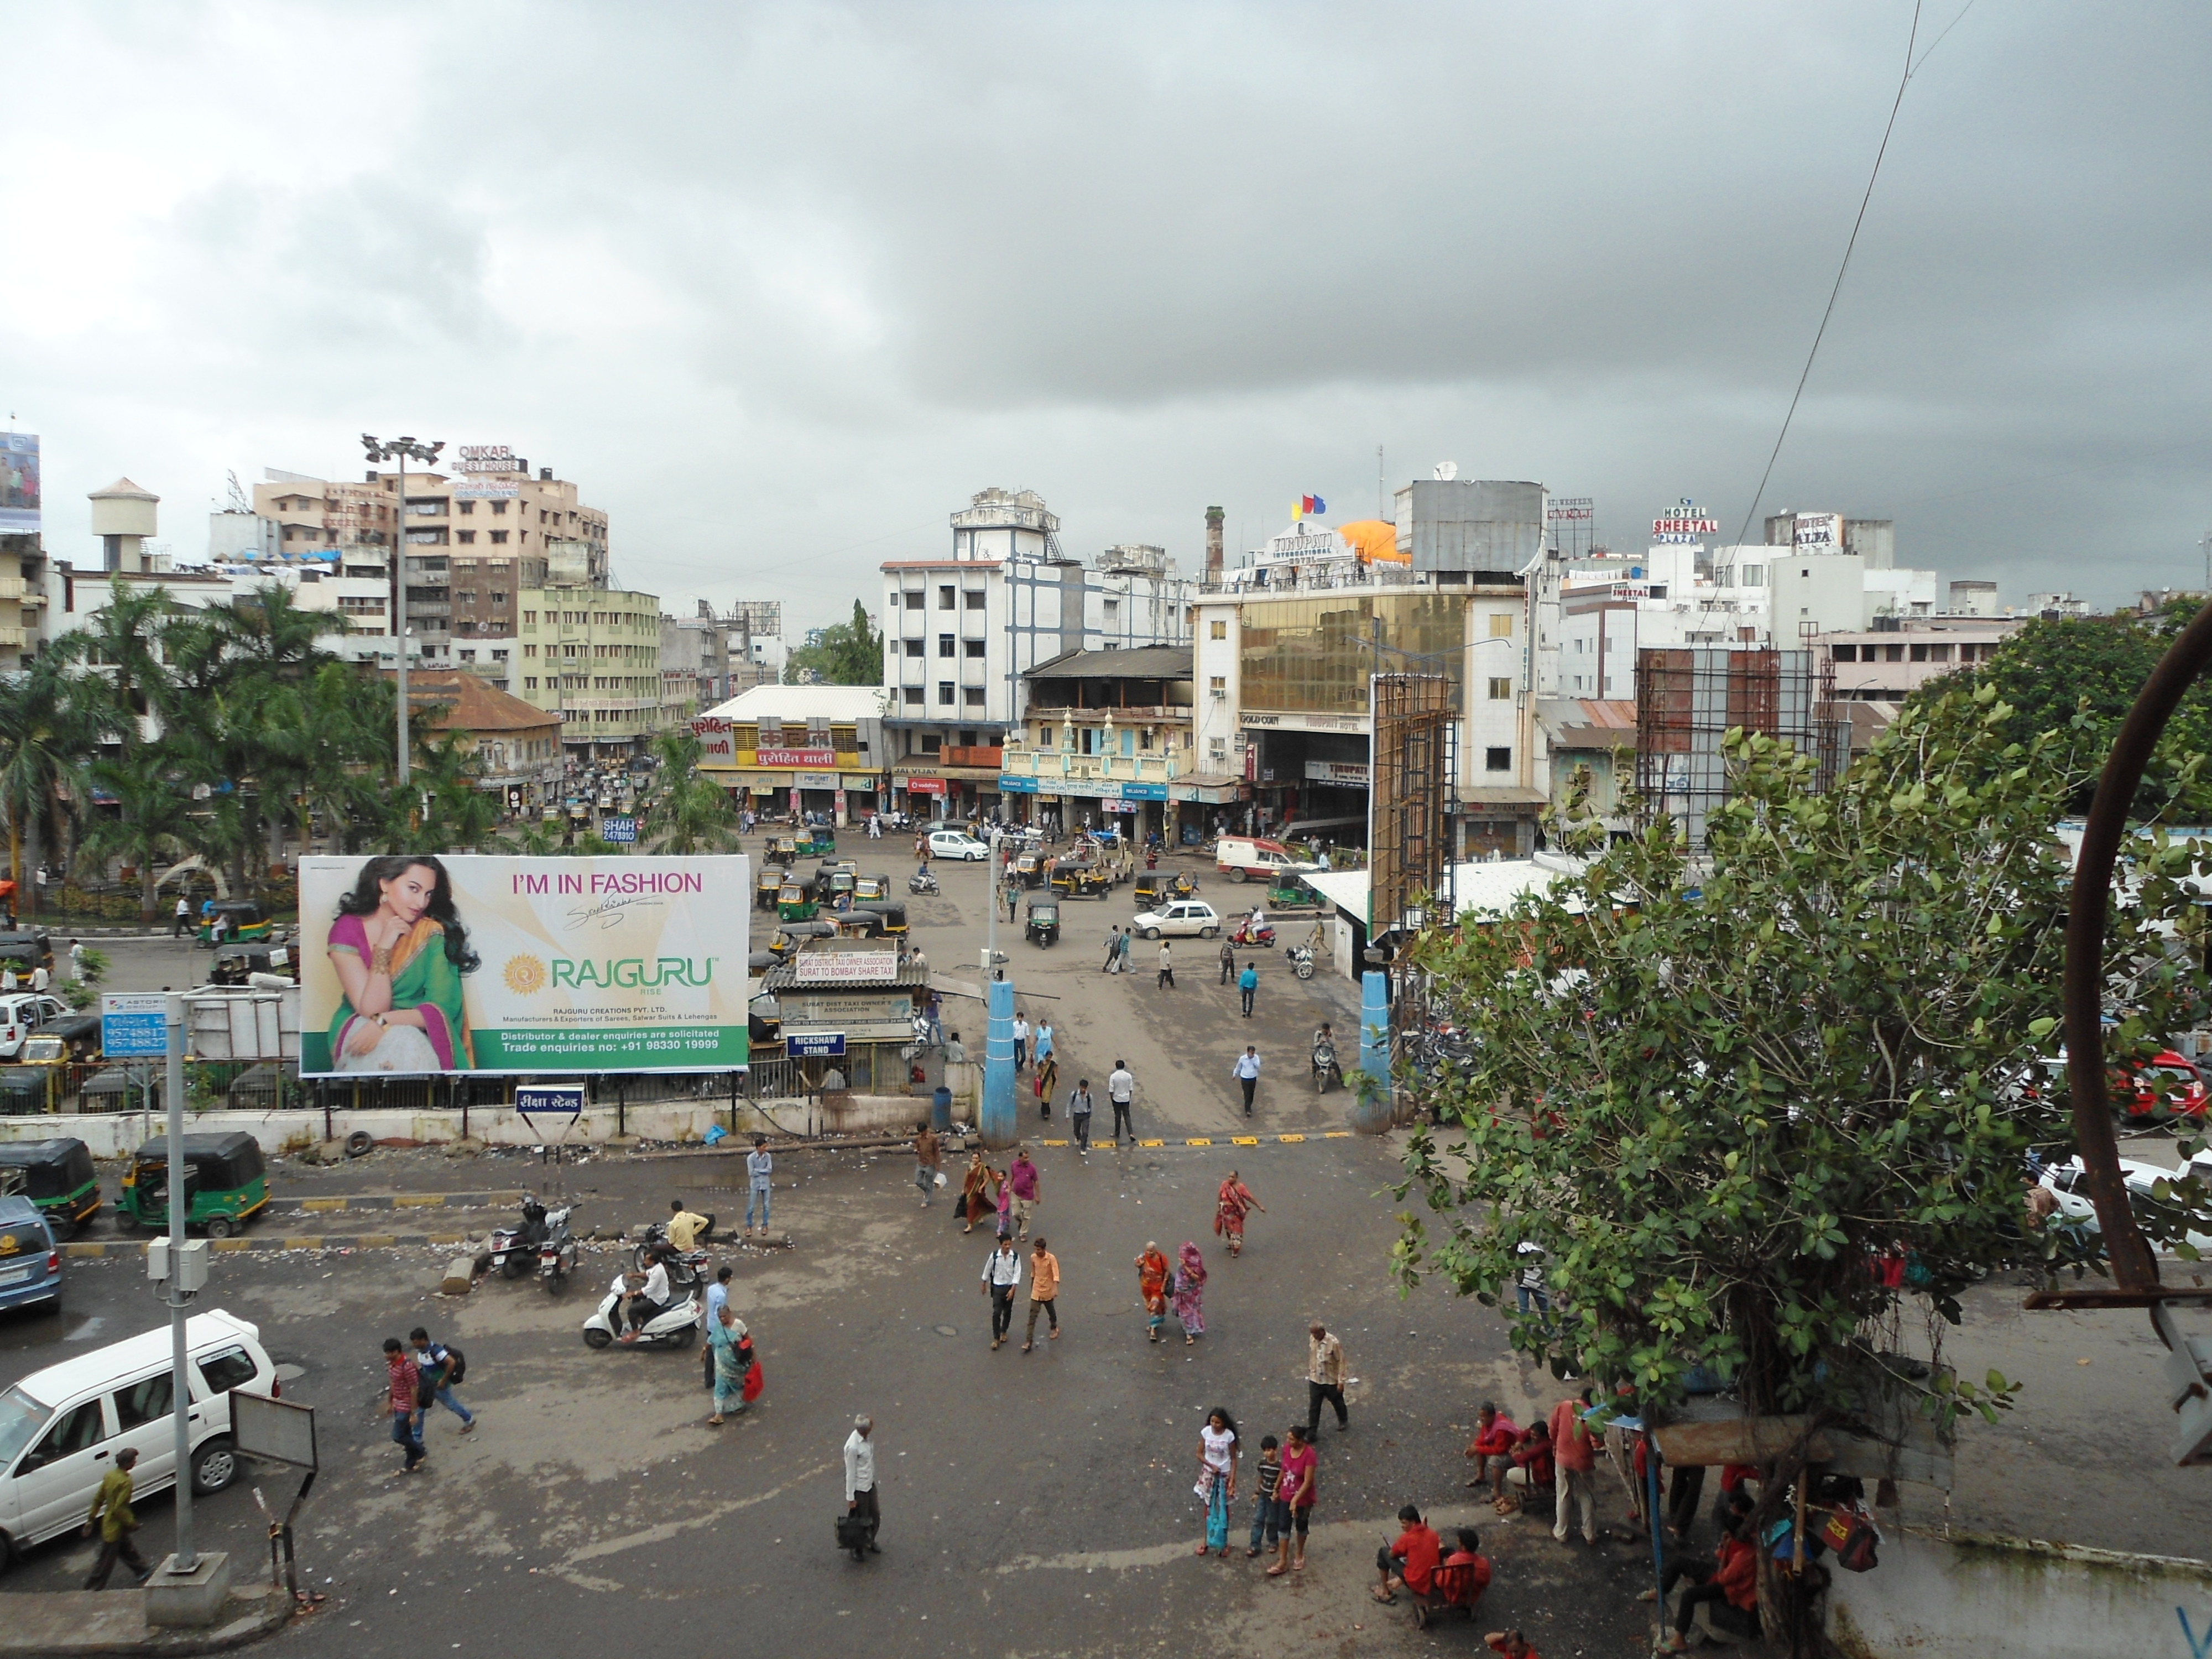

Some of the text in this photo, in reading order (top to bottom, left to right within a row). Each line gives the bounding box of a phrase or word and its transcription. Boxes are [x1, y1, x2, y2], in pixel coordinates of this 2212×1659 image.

[460, 446, 509, 458] OMKAR
[485, 461, 515, 470] HOUSE
[1548, 509, 1590, 520] UVRAJ
[1665, 508, 1705, 518] HOTEL
[1654, 520, 1717, 533] SHEETAL
[1274, 533, 1332, 552] TIRUPATI
[1660, 534, 1695, 543] PLAZA
[1796, 531, 1831, 544] ALFA
[1274, 548, 1331, 558] INTERNATIONAL
[1289, 556, 1316, 565] HOTEL
[1241, 715, 1279, 724] GOLD COIN
[1306, 717, 1338, 728] TIRUPATI
[1340, 722, 1359, 731] HOTEL
[706, 740, 729, 754] ાળી
[758, 752, 800, 765] પુરોહિત
[1329, 764, 1367, 775] TIRUPATI
[604, 821, 634, 831] SHAH
[604, 831, 634, 840] 2478910
[513, 873, 702, 894] I'M IN FASHION
[815, 958, 834, 967] DISTRICT
[836, 958, 846, 966] TAXI
[552, 957, 712, 989] RAJGURU
[800, 967, 894, 977] SURAT TO BOMBAY SHARE TAXI
[684, 1013, 717, 1021] Lehengas
[107, 1028, 166, 1037] 95748817
[502, 1032, 555, 1041] Distributor
[568, 1032, 600, 1040] dealer
[603, 1031, 648, 1041] enquiries
[669, 1030, 719, 1038] solicitated
[107, 1037, 166, 1047] 95748827
[795, 1036, 837, 1045] RICKSHAW
[502, 1040, 718, 1053] Trade enquiries no: +91 98330 19999
[803, 1046, 829, 1055] STAND
